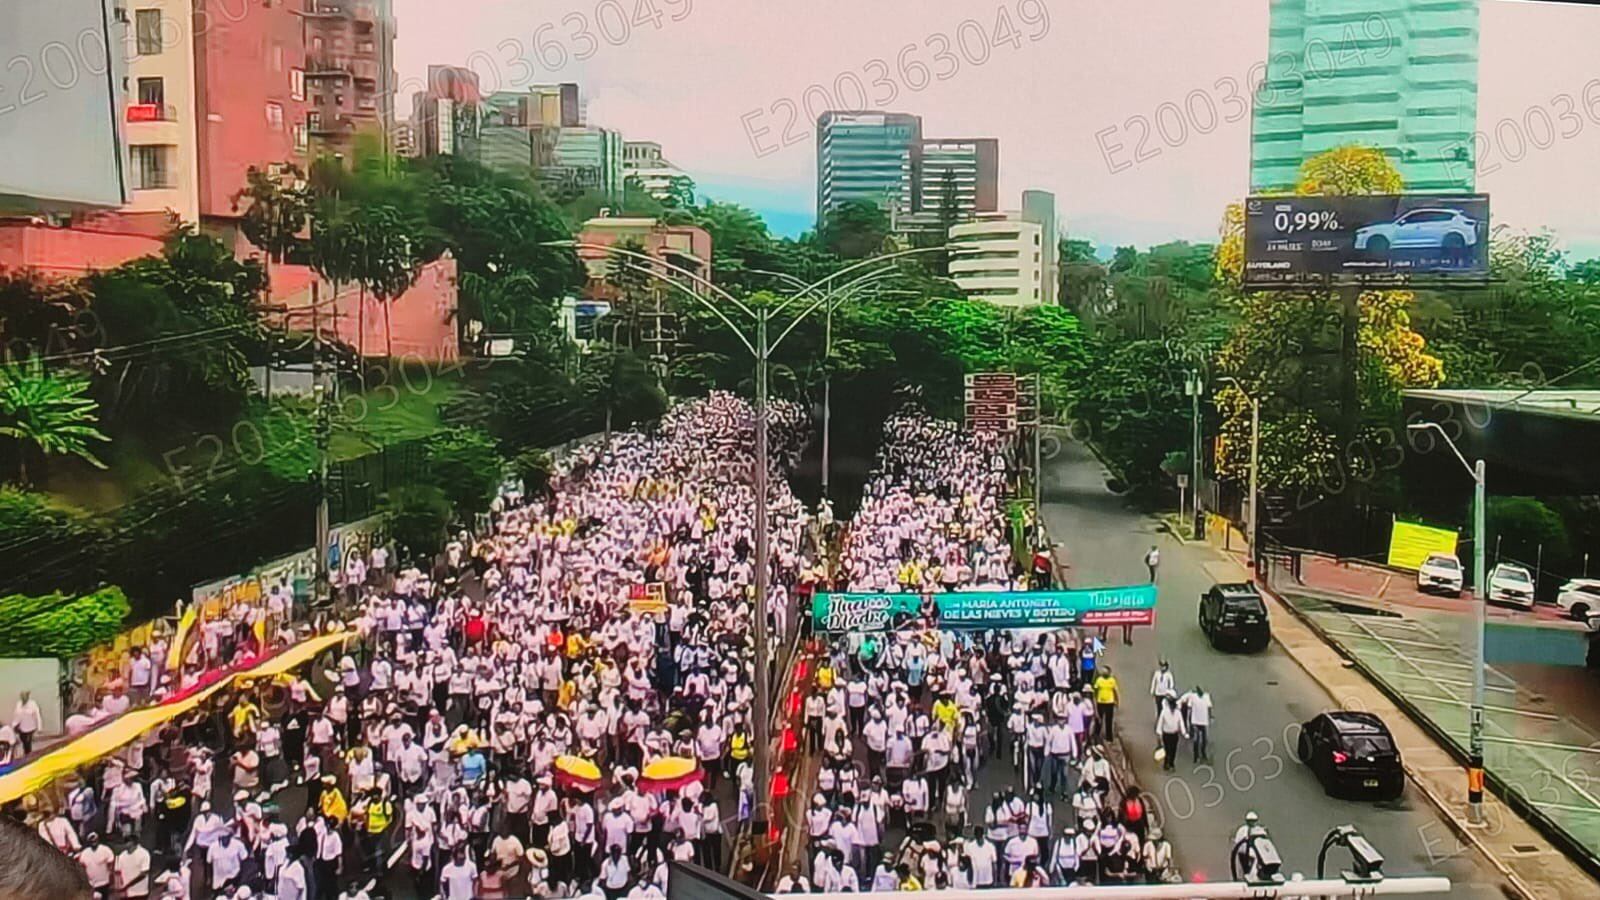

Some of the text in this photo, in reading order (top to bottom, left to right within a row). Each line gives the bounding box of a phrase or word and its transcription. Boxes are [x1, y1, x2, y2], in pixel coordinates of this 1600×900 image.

[1274, 211, 1338, 234] 0,99%
[943, 610, 960, 619] DE
[961, 609, 982, 619] LAS
[1024, 609, 1031, 618] Y
